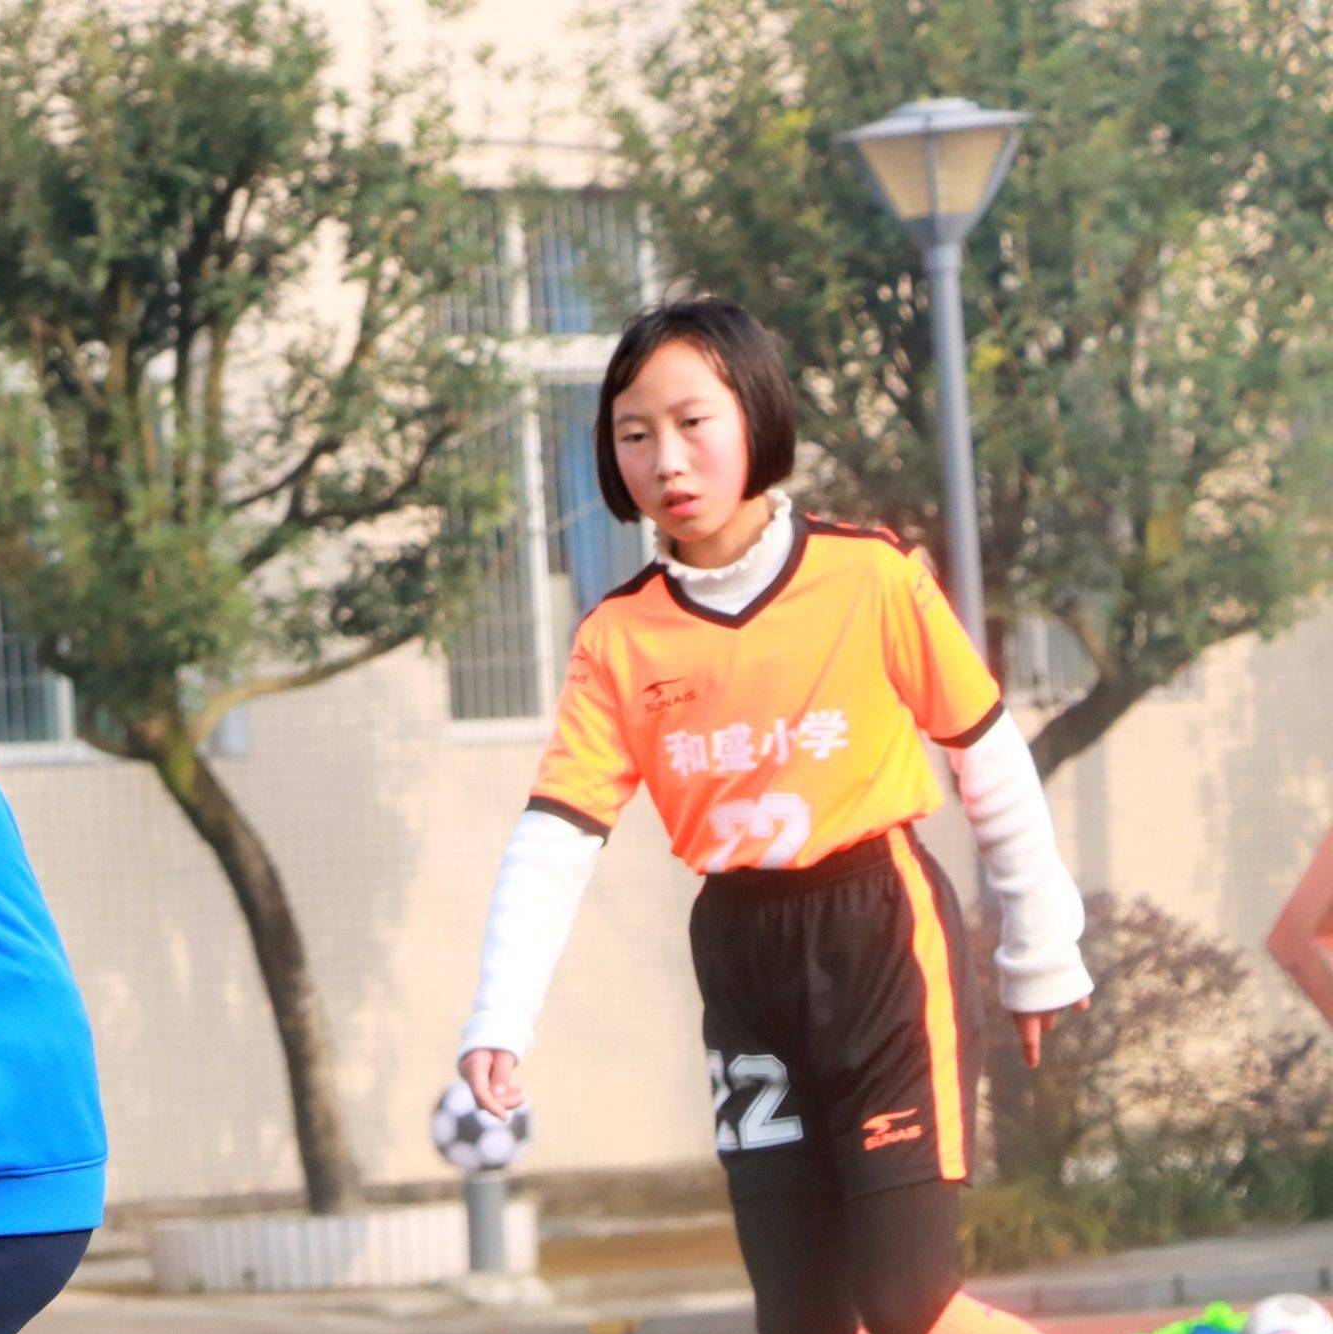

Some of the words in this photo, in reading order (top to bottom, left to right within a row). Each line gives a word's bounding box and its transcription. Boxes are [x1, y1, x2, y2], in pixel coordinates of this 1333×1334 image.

[644, 689, 696, 713] SUNAIS
[664, 709, 849, 778] 和盛小学
